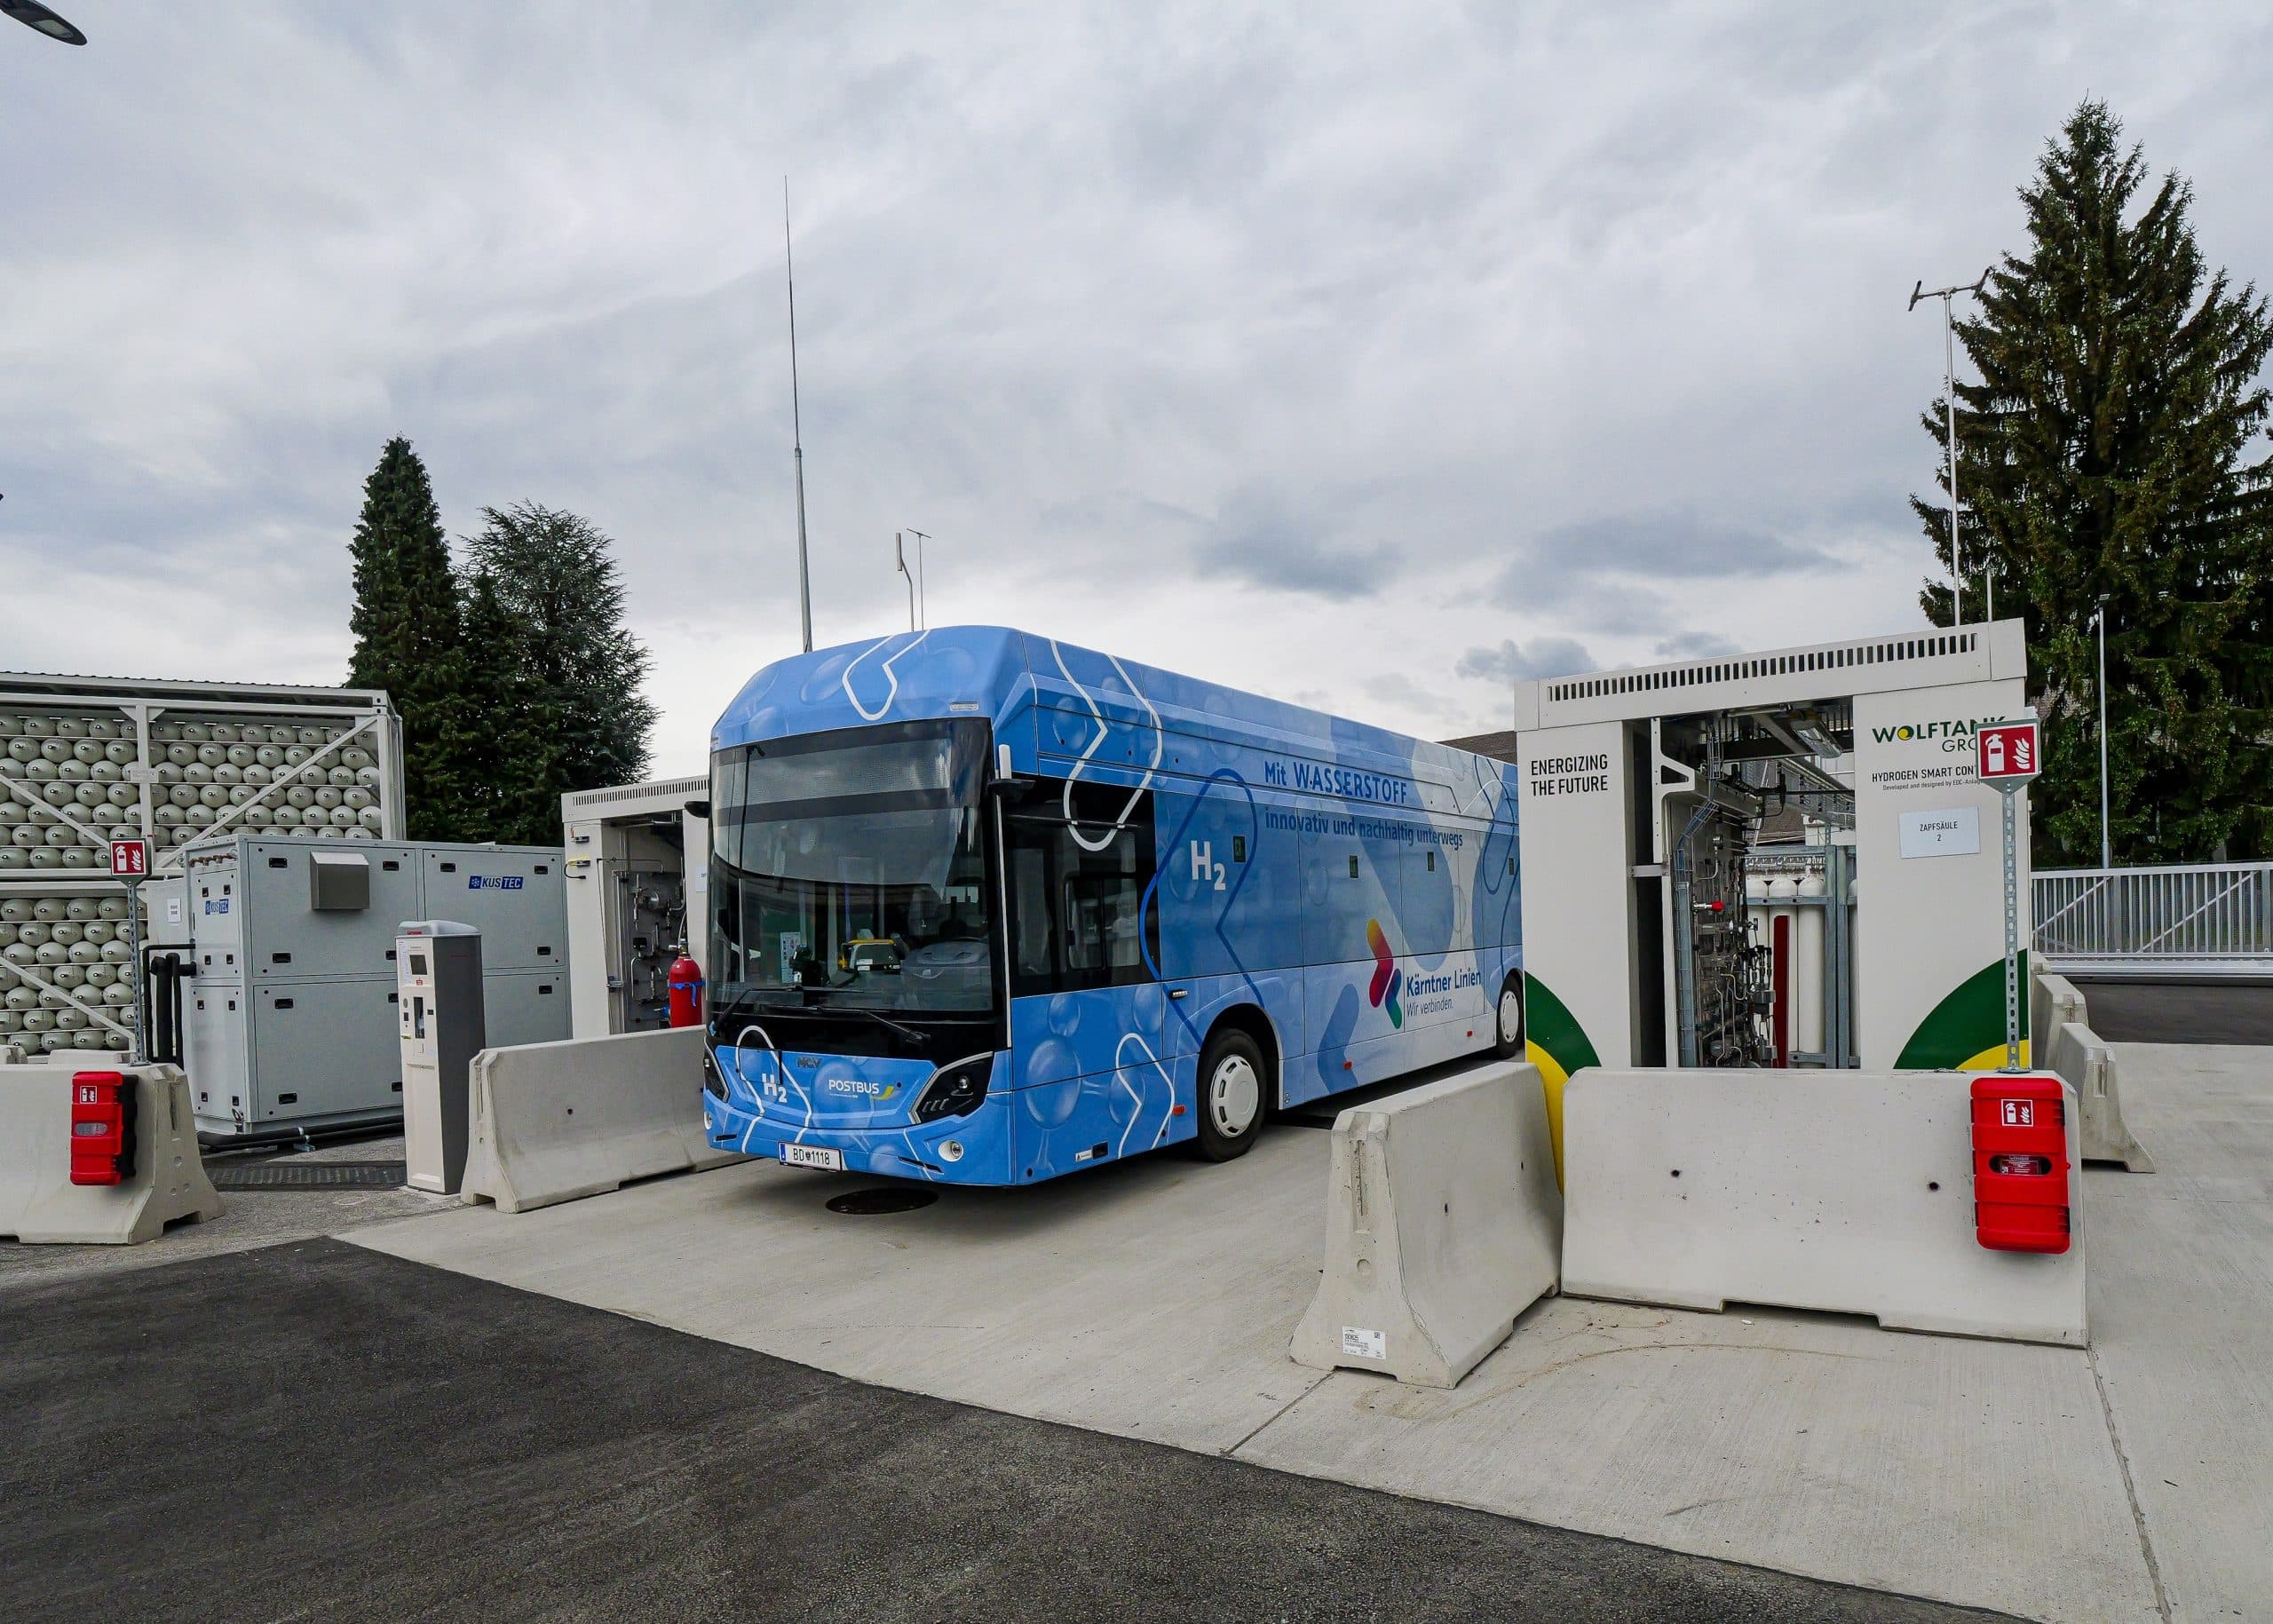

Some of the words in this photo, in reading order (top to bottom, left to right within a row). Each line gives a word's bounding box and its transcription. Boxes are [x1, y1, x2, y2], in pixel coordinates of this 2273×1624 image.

[1872, 717, 2006, 744] WOLFTA
[1531, 754, 1608, 776] ENERGIZING
[1872, 769, 1918, 783] HYDROGEN
[1921, 767, 1952, 779] SMART
[1264, 761, 1287, 786] Mit
[1294, 761, 1407, 804] WASSERSTOFF
[1531, 780, 1556, 796] THE
[1558, 775, 1608, 795] FUTURE
[1882, 782, 1909, 791] Developed
[1921, 780, 1944, 789] designed
[1265, 807, 1329, 834] innovativ
[1333, 818, 1356, 837] und
[1358, 820, 1414, 847] nachhaltig
[1416, 827, 1464, 851] unterwegs
[1920, 820, 1959, 832] ZAPFSÄULE
[1191, 839, 1226, 891] H2
[1406, 973, 1452, 998] Kärntner
[1454, 967, 1481, 989] Linien
[1406, 1001, 1419, 1018] Wir
[1421, 997, 1453, 1015] verbinden.
[762, 1073, 788, 1103] H2
[828, 1079, 880, 1095] POSTBUS
[793, 1147, 804, 1161] BD
[812, 1150, 830, 1166] 1118
